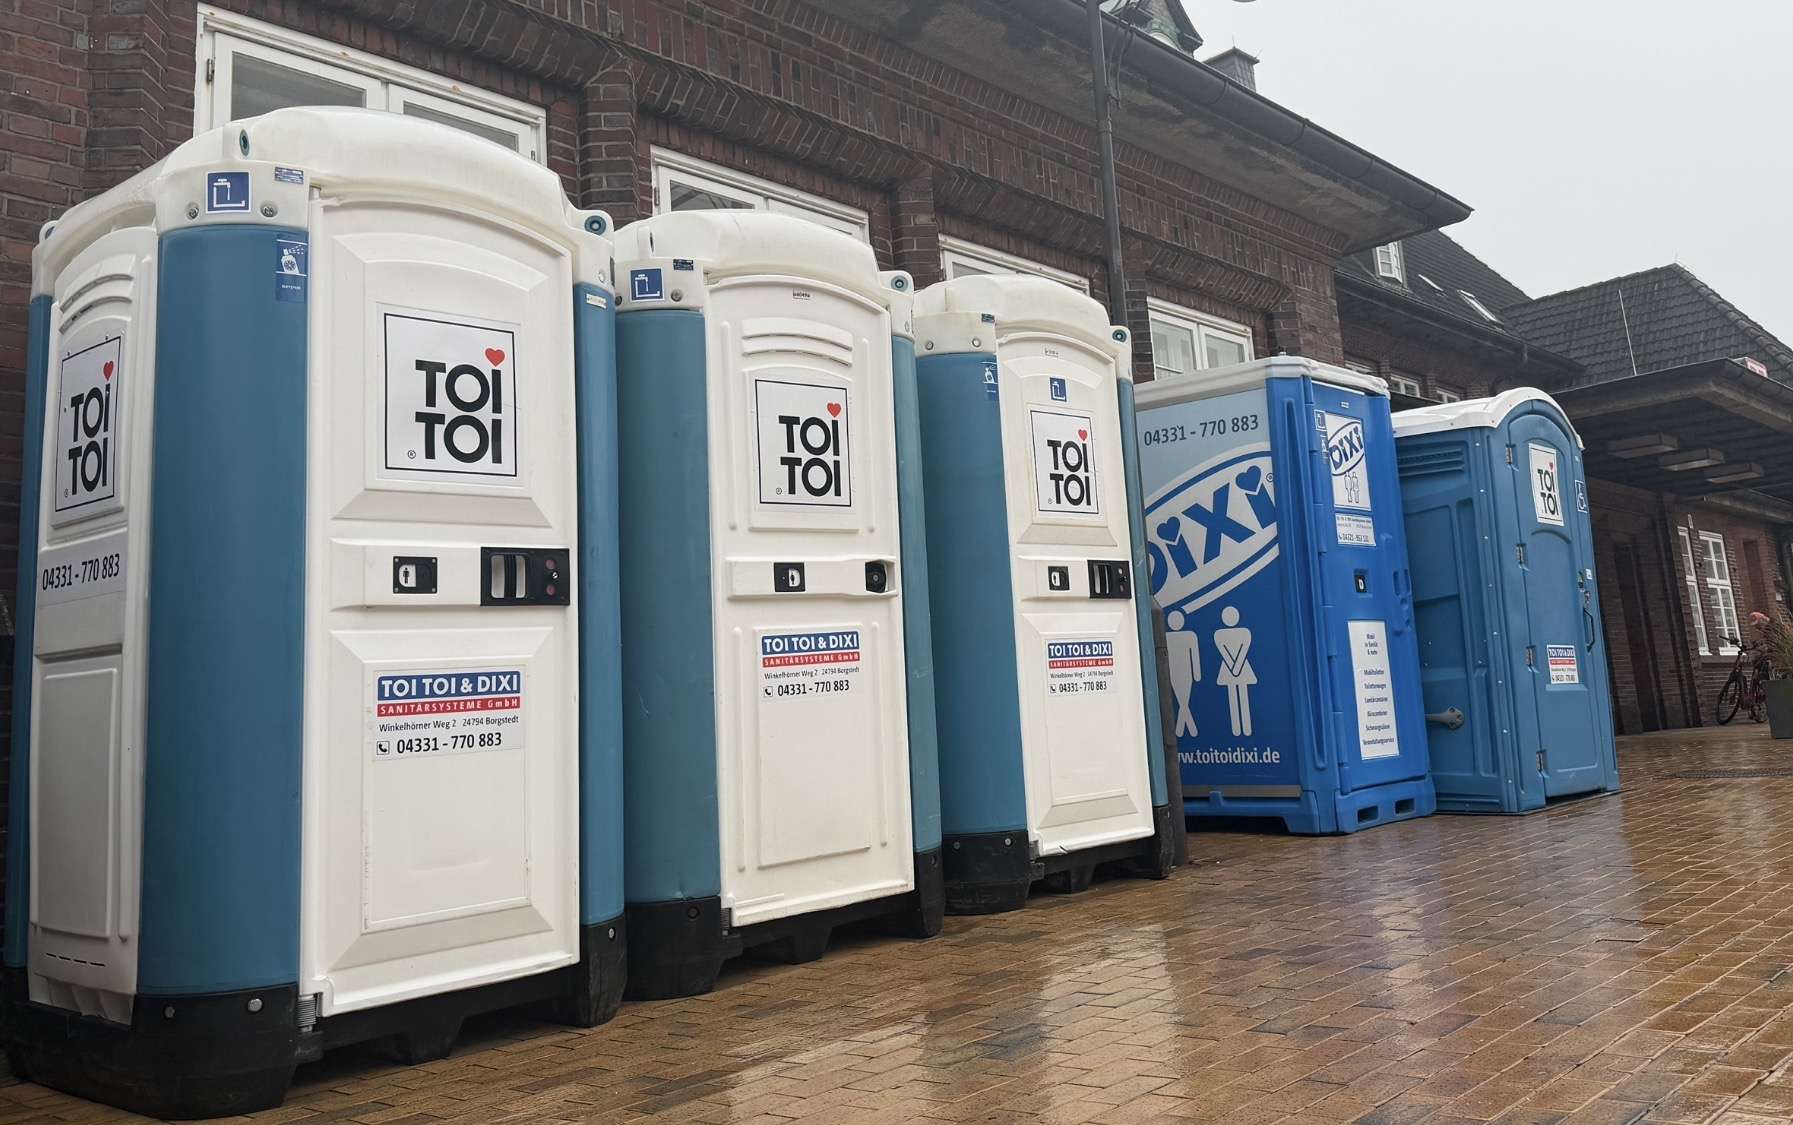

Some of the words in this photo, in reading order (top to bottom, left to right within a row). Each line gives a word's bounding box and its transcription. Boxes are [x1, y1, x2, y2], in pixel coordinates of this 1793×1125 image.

[415, 359, 502, 414] TOI
[71, 384, 110, 442] TOI
[415, 411, 502, 464] TOI
[779, 415, 840, 456] TOI
[1144, 425, 1187, 446] 04331
[1200, 419, 1226, 438] 770
[1231, 414, 1259, 433] 883
[68, 437, 108, 495] TOI
[1047, 440, 1089, 473] TOI
[780, 456, 841, 497] TOI
[1050, 472, 1091, 506] TOI
[1537, 469, 1555, 493] TOI
[1540, 492, 1559, 515] TOI
[42, 565, 72, 591] 04331
[82, 559, 99, 584] 770
[102, 553, 120, 579] 883
[764, 637, 788, 652] TOI
[792, 636, 815, 651] TOI
[818, 636, 826, 649] &
[829, 634, 857, 648] DIXI
[1049, 645, 1065, 656] TOI
[1067, 644, 1083, 655] TOI
[1085, 645, 1091, 655] &
[1092, 643, 1112, 655] DIXI
[382, 678, 416, 697] TOI
[422, 677, 456, 695] TOI
[460, 677, 473, 693] &
[478, 674, 517, 692] DIXI
[777, 683, 807, 697] 04331
[814, 680, 831, 693] 770
[833, 679, 850, 691] 883
[1059, 683, 1078, 693] 04331
[1083, 681, 1095, 691] 770
[380, 700, 481, 715] SANITÄRSYSTEME
[487, 698, 518, 708] GmbH
[379, 721, 430, 732] Winkelhörner
[433, 719, 450, 730] Weg
[452, 719, 457, 727] 2
[462, 717, 484, 726] 24794
[485, 715, 519, 726] Borgstedt
[396, 737, 439, 754] 04331
[451, 734, 475, 749] 770
[479, 732, 502, 747] 883
